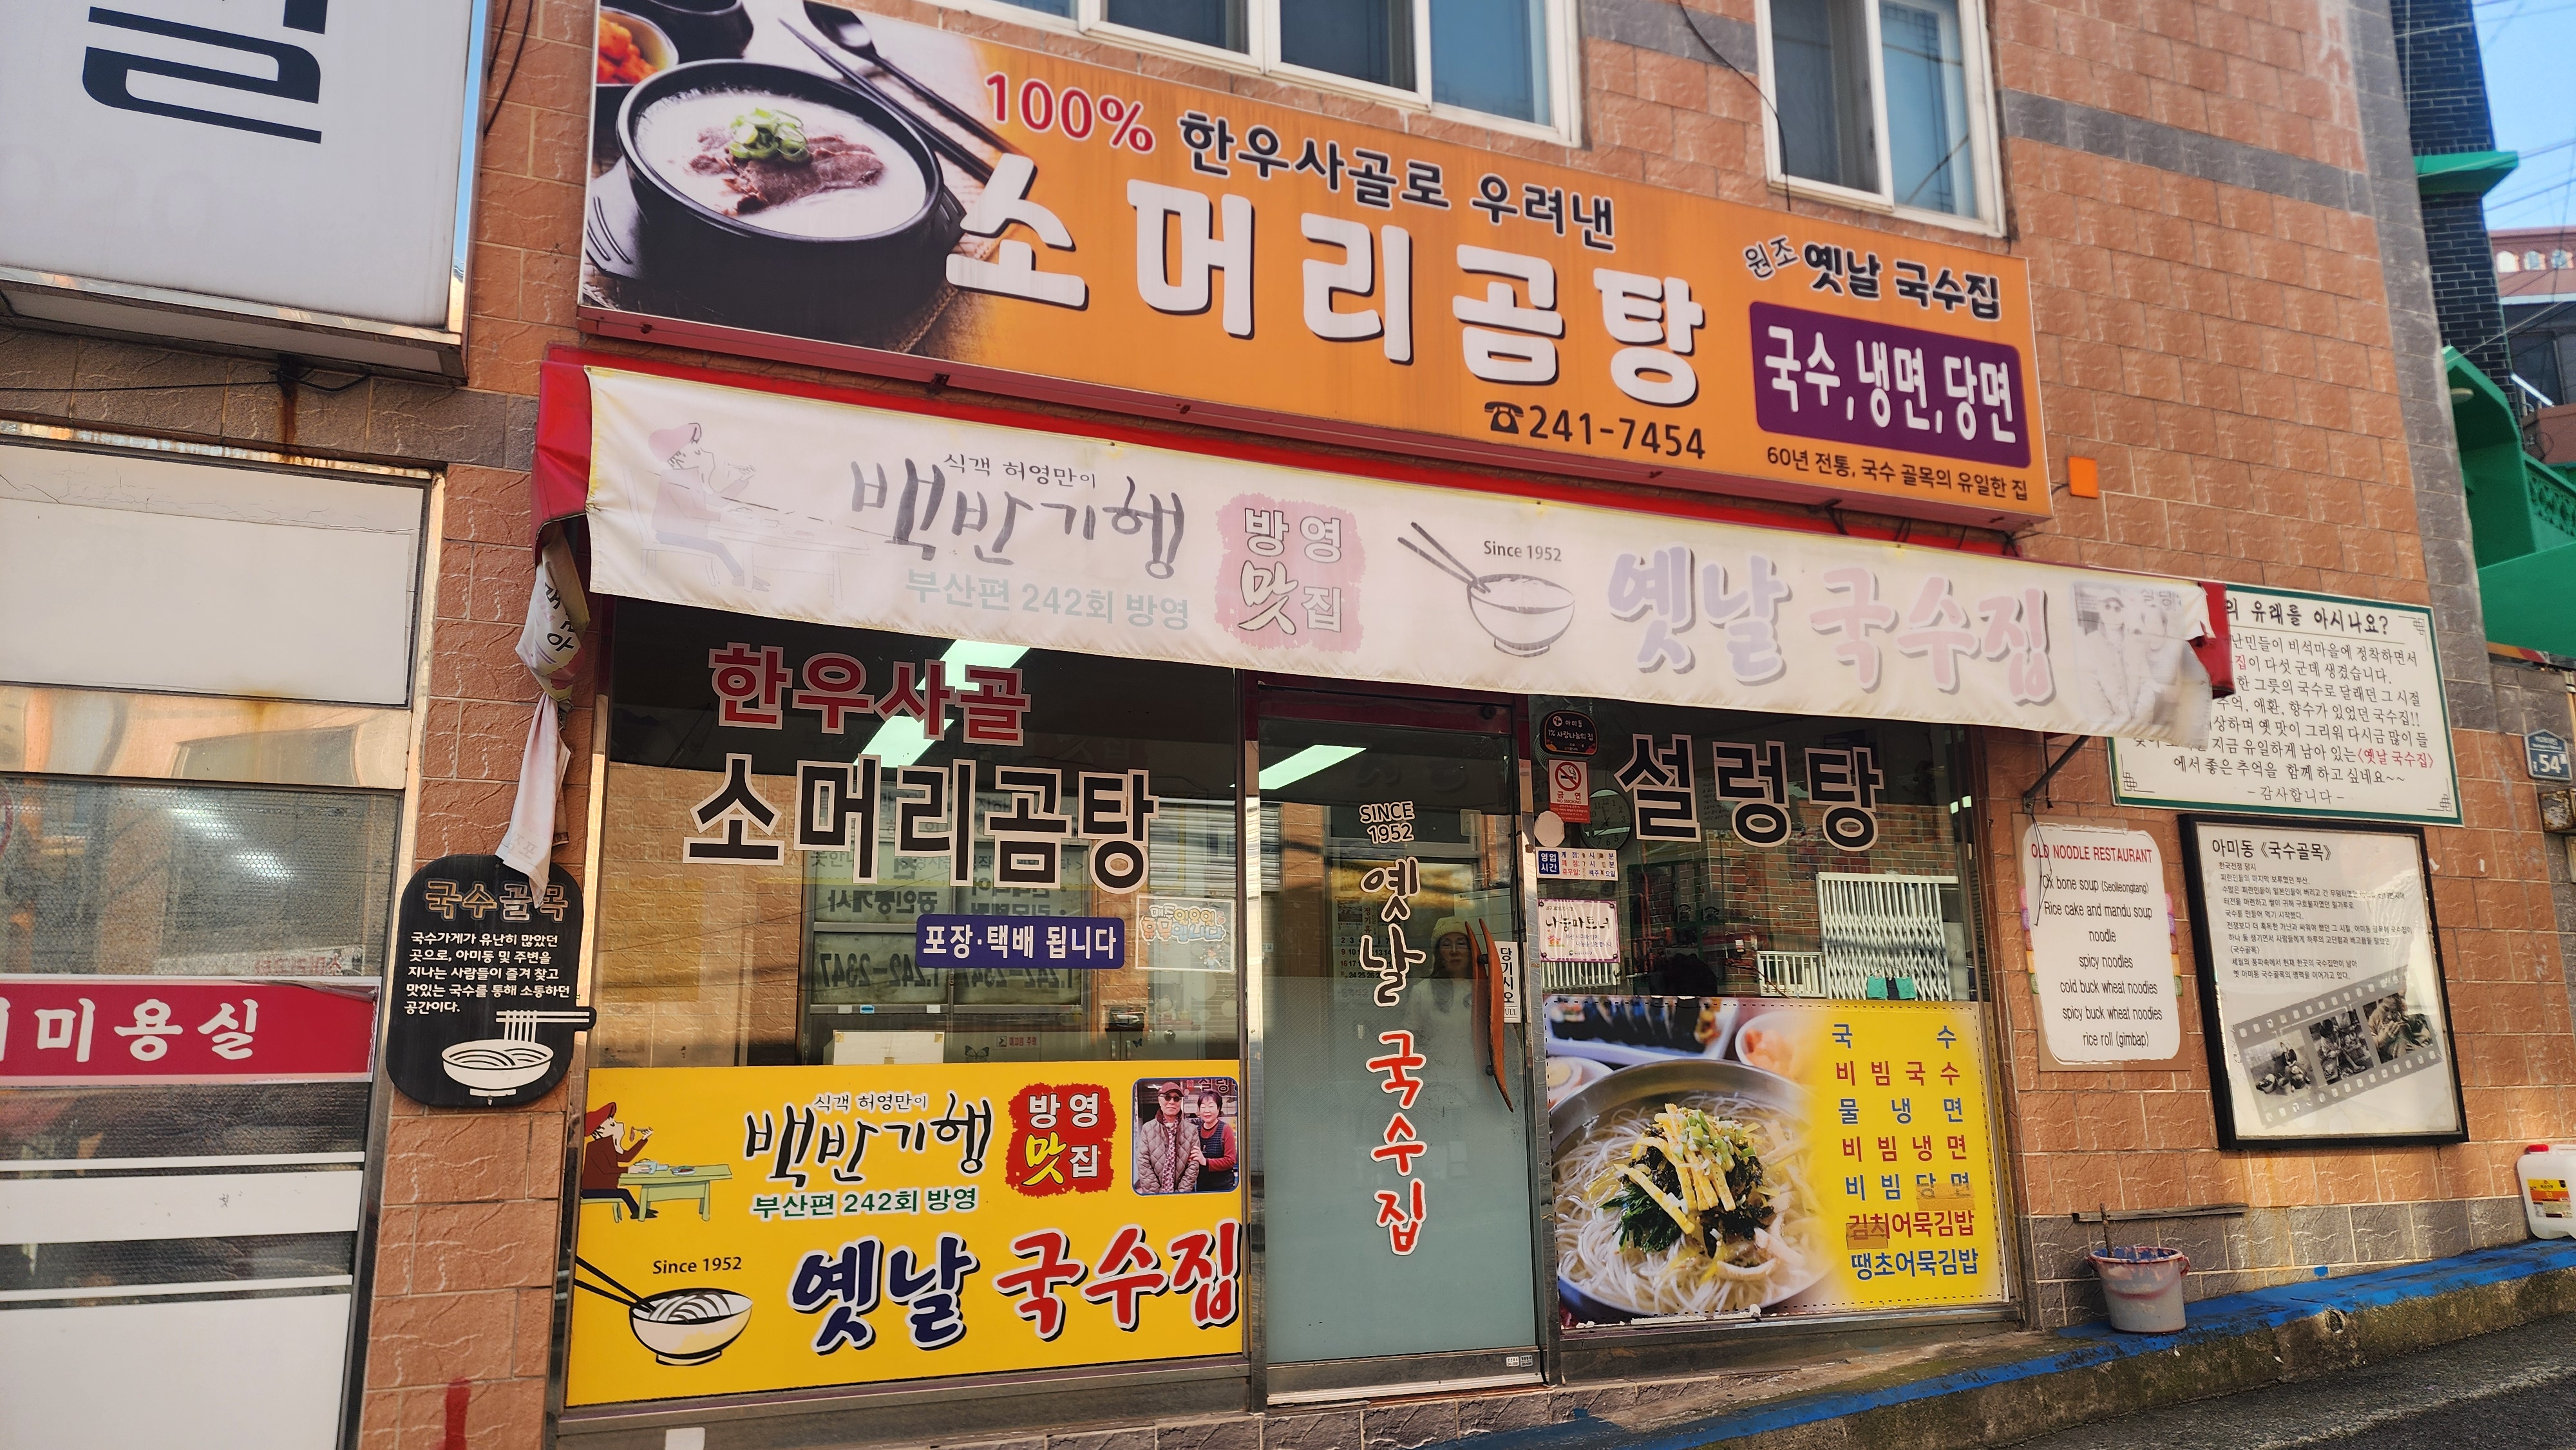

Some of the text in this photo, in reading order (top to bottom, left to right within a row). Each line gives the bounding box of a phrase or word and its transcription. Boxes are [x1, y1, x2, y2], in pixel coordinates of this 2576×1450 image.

[985, 71, 1615, 253] 100% 한우사골로 우려낸
[945, 153, 1705, 408] 소머리곰탕
[1743, 235, 2001, 321] 원조 옛날 국수집
[941, 451, 1098, 490] 식객 허영만이
[1766, 447, 2028, 502] 60년 전통, 국수 골목의 유일한 집
[849, 458, 1185, 581] 백반기행
[1483, 538, 1563, 562] Since 1952
[905, 571, 1191, 631] 부산편 242회 방영
[1607, 545, 2058, 705] 옛날 국수집
[2251, 600, 2389, 635] 유래를 아시나요?
[2289, 639, 2352, 660] 비석마을에
[2356, 645, 2418, 666] 정착하면서
[2235, 654, 2392, 684] 집이 다섯 군데 생겼습니다.
[708, 642, 1032, 747] 한우사골
[2238, 675, 2421, 707] 한 그릇의 국수로 달래던 그 시절
[2289, 701, 2328, 719] 향수가
[2333, 704, 2369, 722] 있었던
[2372, 708, 2420, 727] 국수집!!
[2259, 719, 2271, 735] 옛
[2275, 720, 2300, 738] 맛이
[2306, 724, 2344, 740] 그리워
[2348, 728, 2385, 744] 다시금
[2389, 730, 2412, 746] 많이
[2212, 737, 2239, 754] 지금
[2243, 739, 2297, 758] 유일하게
[2300, 744, 2327, 760] 남아
[2174, 755, 2201, 773] 에서
[2205, 757, 2232, 776] 좋은
[2237, 759, 2277, 778] 추억을
[2287, 763, 2313, 782] 함께
[2318, 766, 2343, 782] 하고
[1614, 733, 1884, 851] 설렁탕
[683, 753, 1159, 894] 소머리곰탕
[1359, 801, 1415, 824] SINCE
[1367, 822, 1414, 844] 1952
[1540, 852, 1557, 862] 영업
[2031, 843, 2152, 863] OLD NOODLE RESTAURANT
[2212, 839, 2254, 859] 아미동
[1540, 863, 1557, 872] 시간
[2042, 874, 2054, 889] Ox
[2056, 876, 2077, 890] bone
[2079, 880, 2099, 892] soup
[423, 878, 569, 921] 국수골목
[2044, 901, 2153, 920] Rice cake and mandu soup
[411, 932, 558, 947] 국수가게가 유난히 많았던
[1046, 926, 1117, 961] 됩니다
[2088, 928, 2117, 943] noodle
[409, 949, 552, 965] 곳으로, 아미동 및 주변을
[2079, 954, 2134, 970] spicy noodles
[408, 966, 559, 981] 지나는 사람들이 즐겨 찾고
[1500, 947, 1515, 1003] 당기시오
[2060, 979, 2078, 993] cold
[2079, 979, 2100, 994] buck
[2101, 980, 2126, 994] wheat
[406, 984, 570, 999] 맛있는 국수를 통해 소통하던
[404, 1001, 460, 1015] 공간이다.
[2062, 1005, 2083, 1021] spicy
[2085, 1006, 2105, 1020] buck
[2107, 1006, 2131, 1020] wheat
[2083, 1031, 2149, 1048] rice roll (gimbap)
[813, 1090, 929, 1113] 식객 허영만이
[1028, 1091, 1101, 1132] 방영
[744, 1091, 993, 1186] 백반기행
[1024, 1132, 1101, 1189] 맛집
[752, 1187, 979, 1222] 부산편 242회 방영
[652, 1255, 743, 1275] Since 1952
[1851, 1248, 1979, 1281] 땡초어묵김밥
[789, 1218, 1243, 1355] 옛날 국수집
